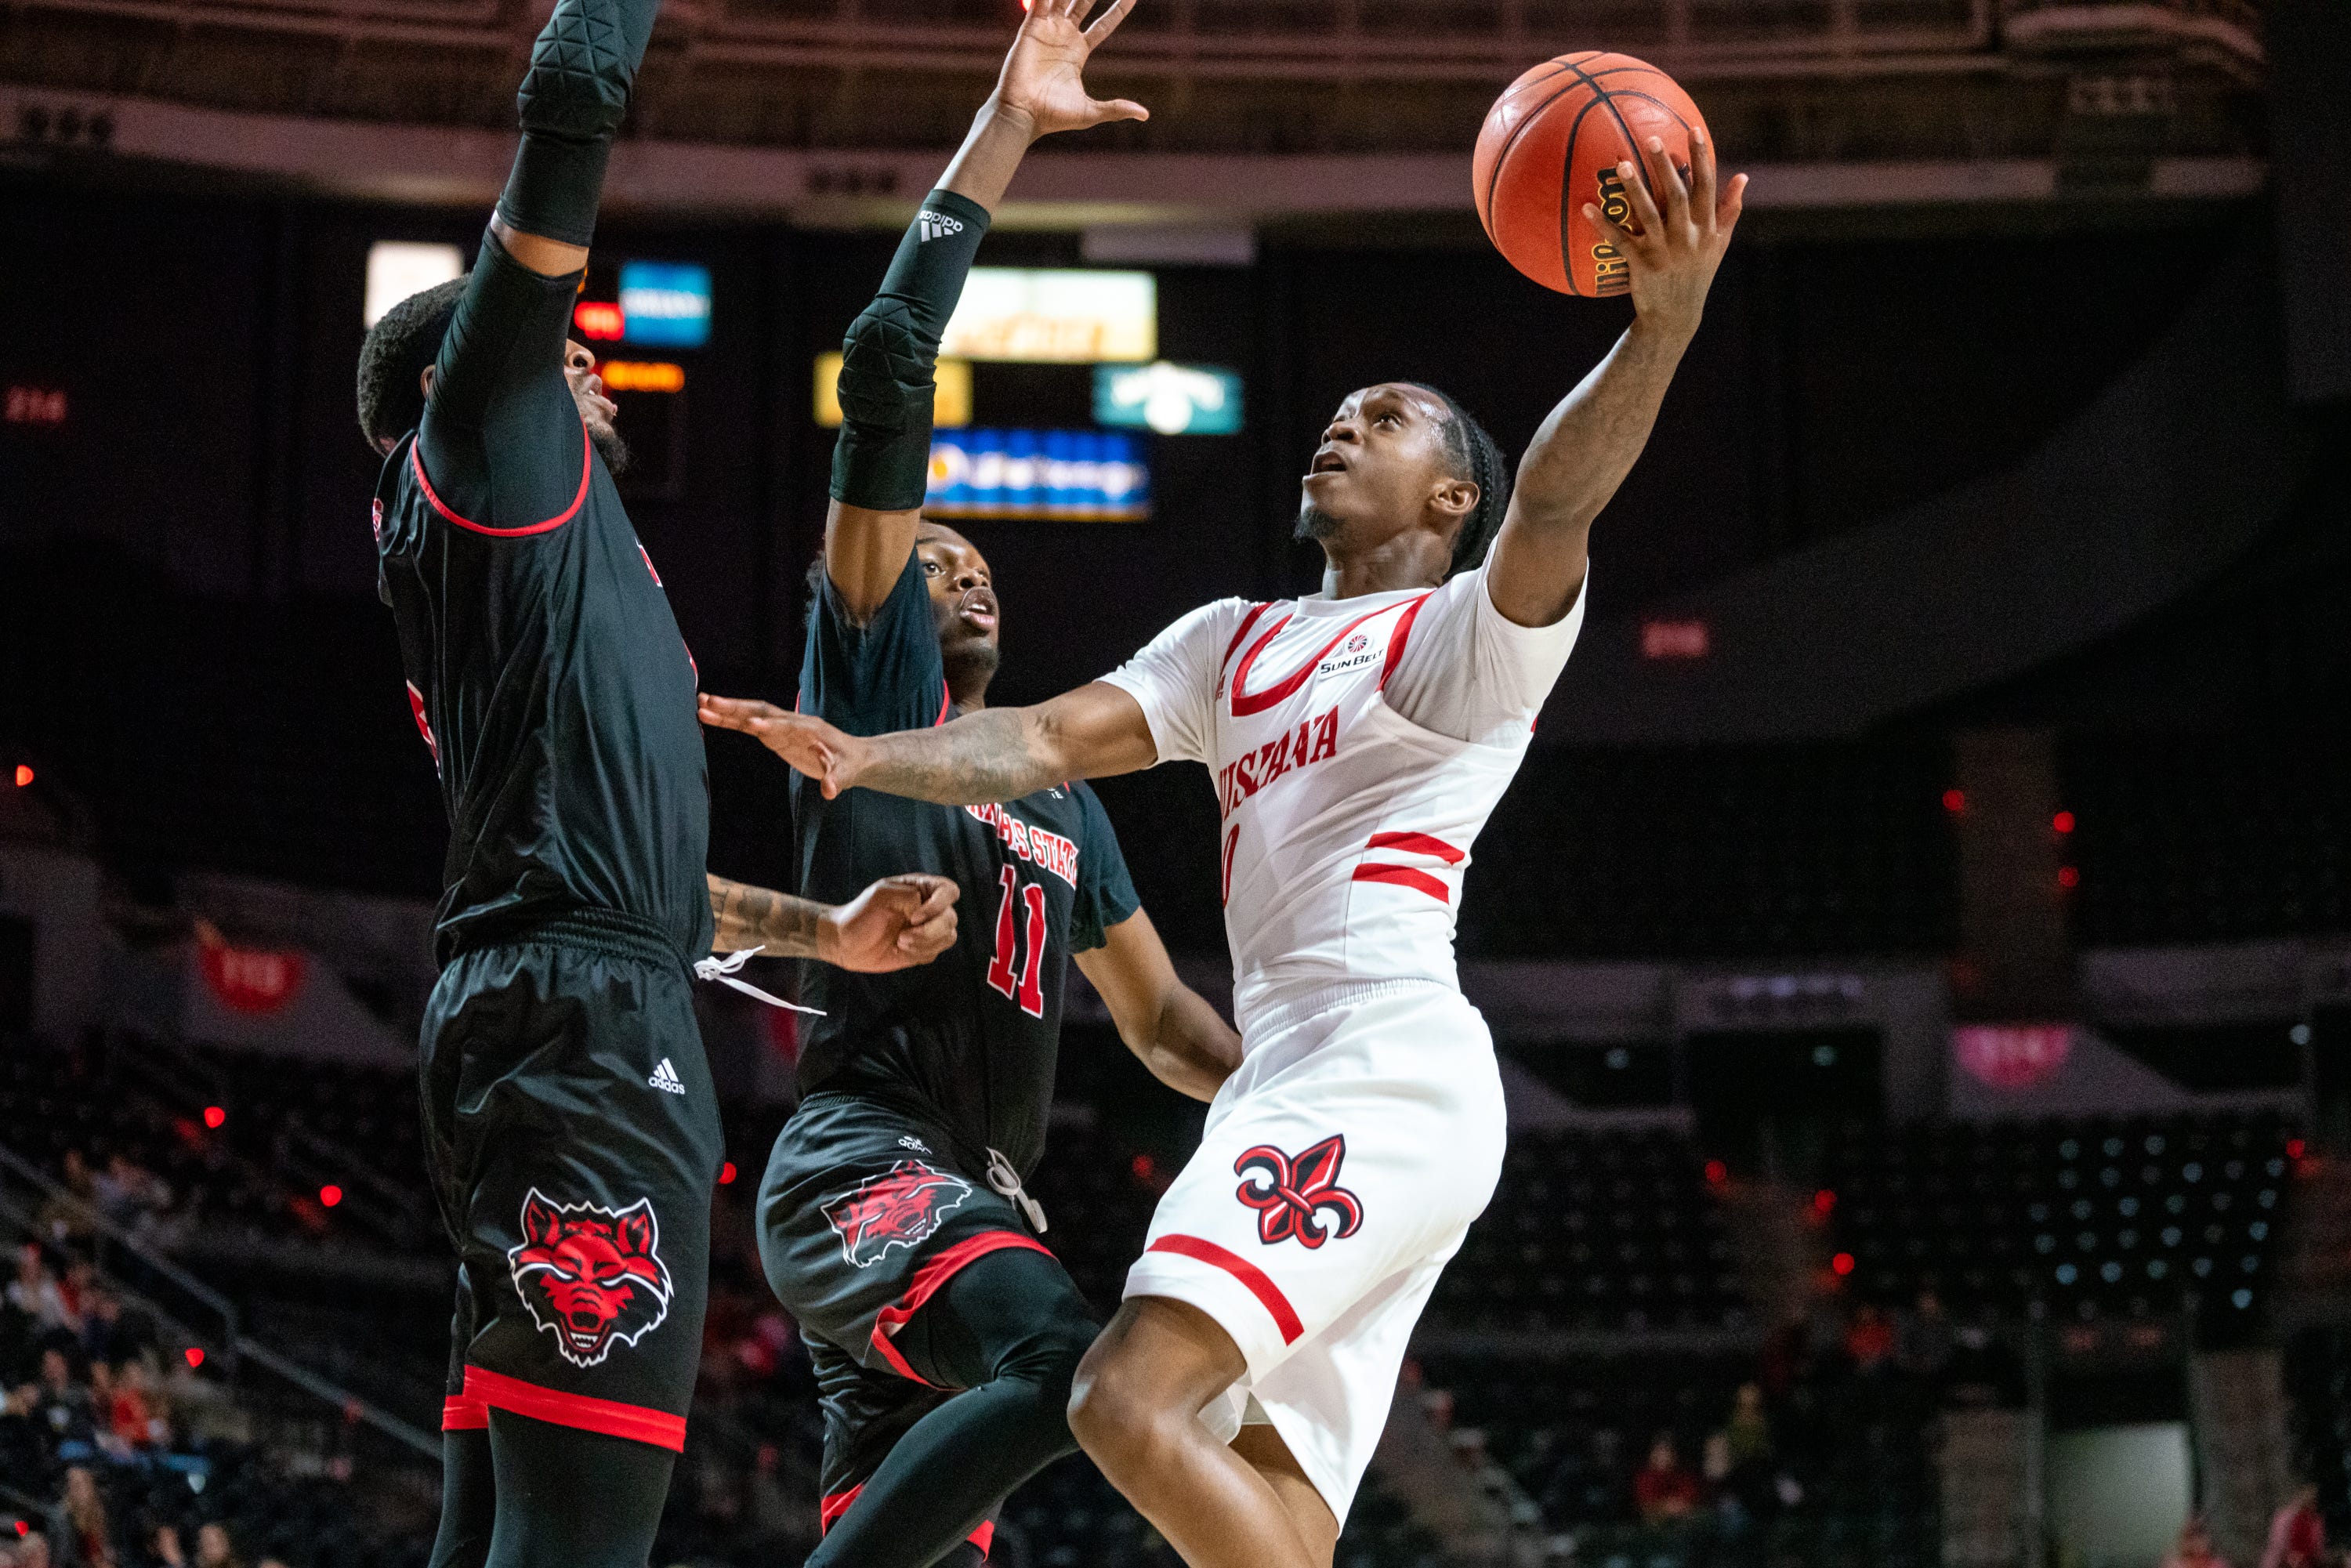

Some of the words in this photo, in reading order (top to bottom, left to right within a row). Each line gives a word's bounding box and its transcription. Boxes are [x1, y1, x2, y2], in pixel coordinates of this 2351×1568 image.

[918, 209, 963, 232] adidas
[1591, 167, 1633, 295] Wilon
[1320, 660, 1352, 675] SUN
[1353, 648, 1384, 666] BELT
[987, 863, 1047, 1019] 11
